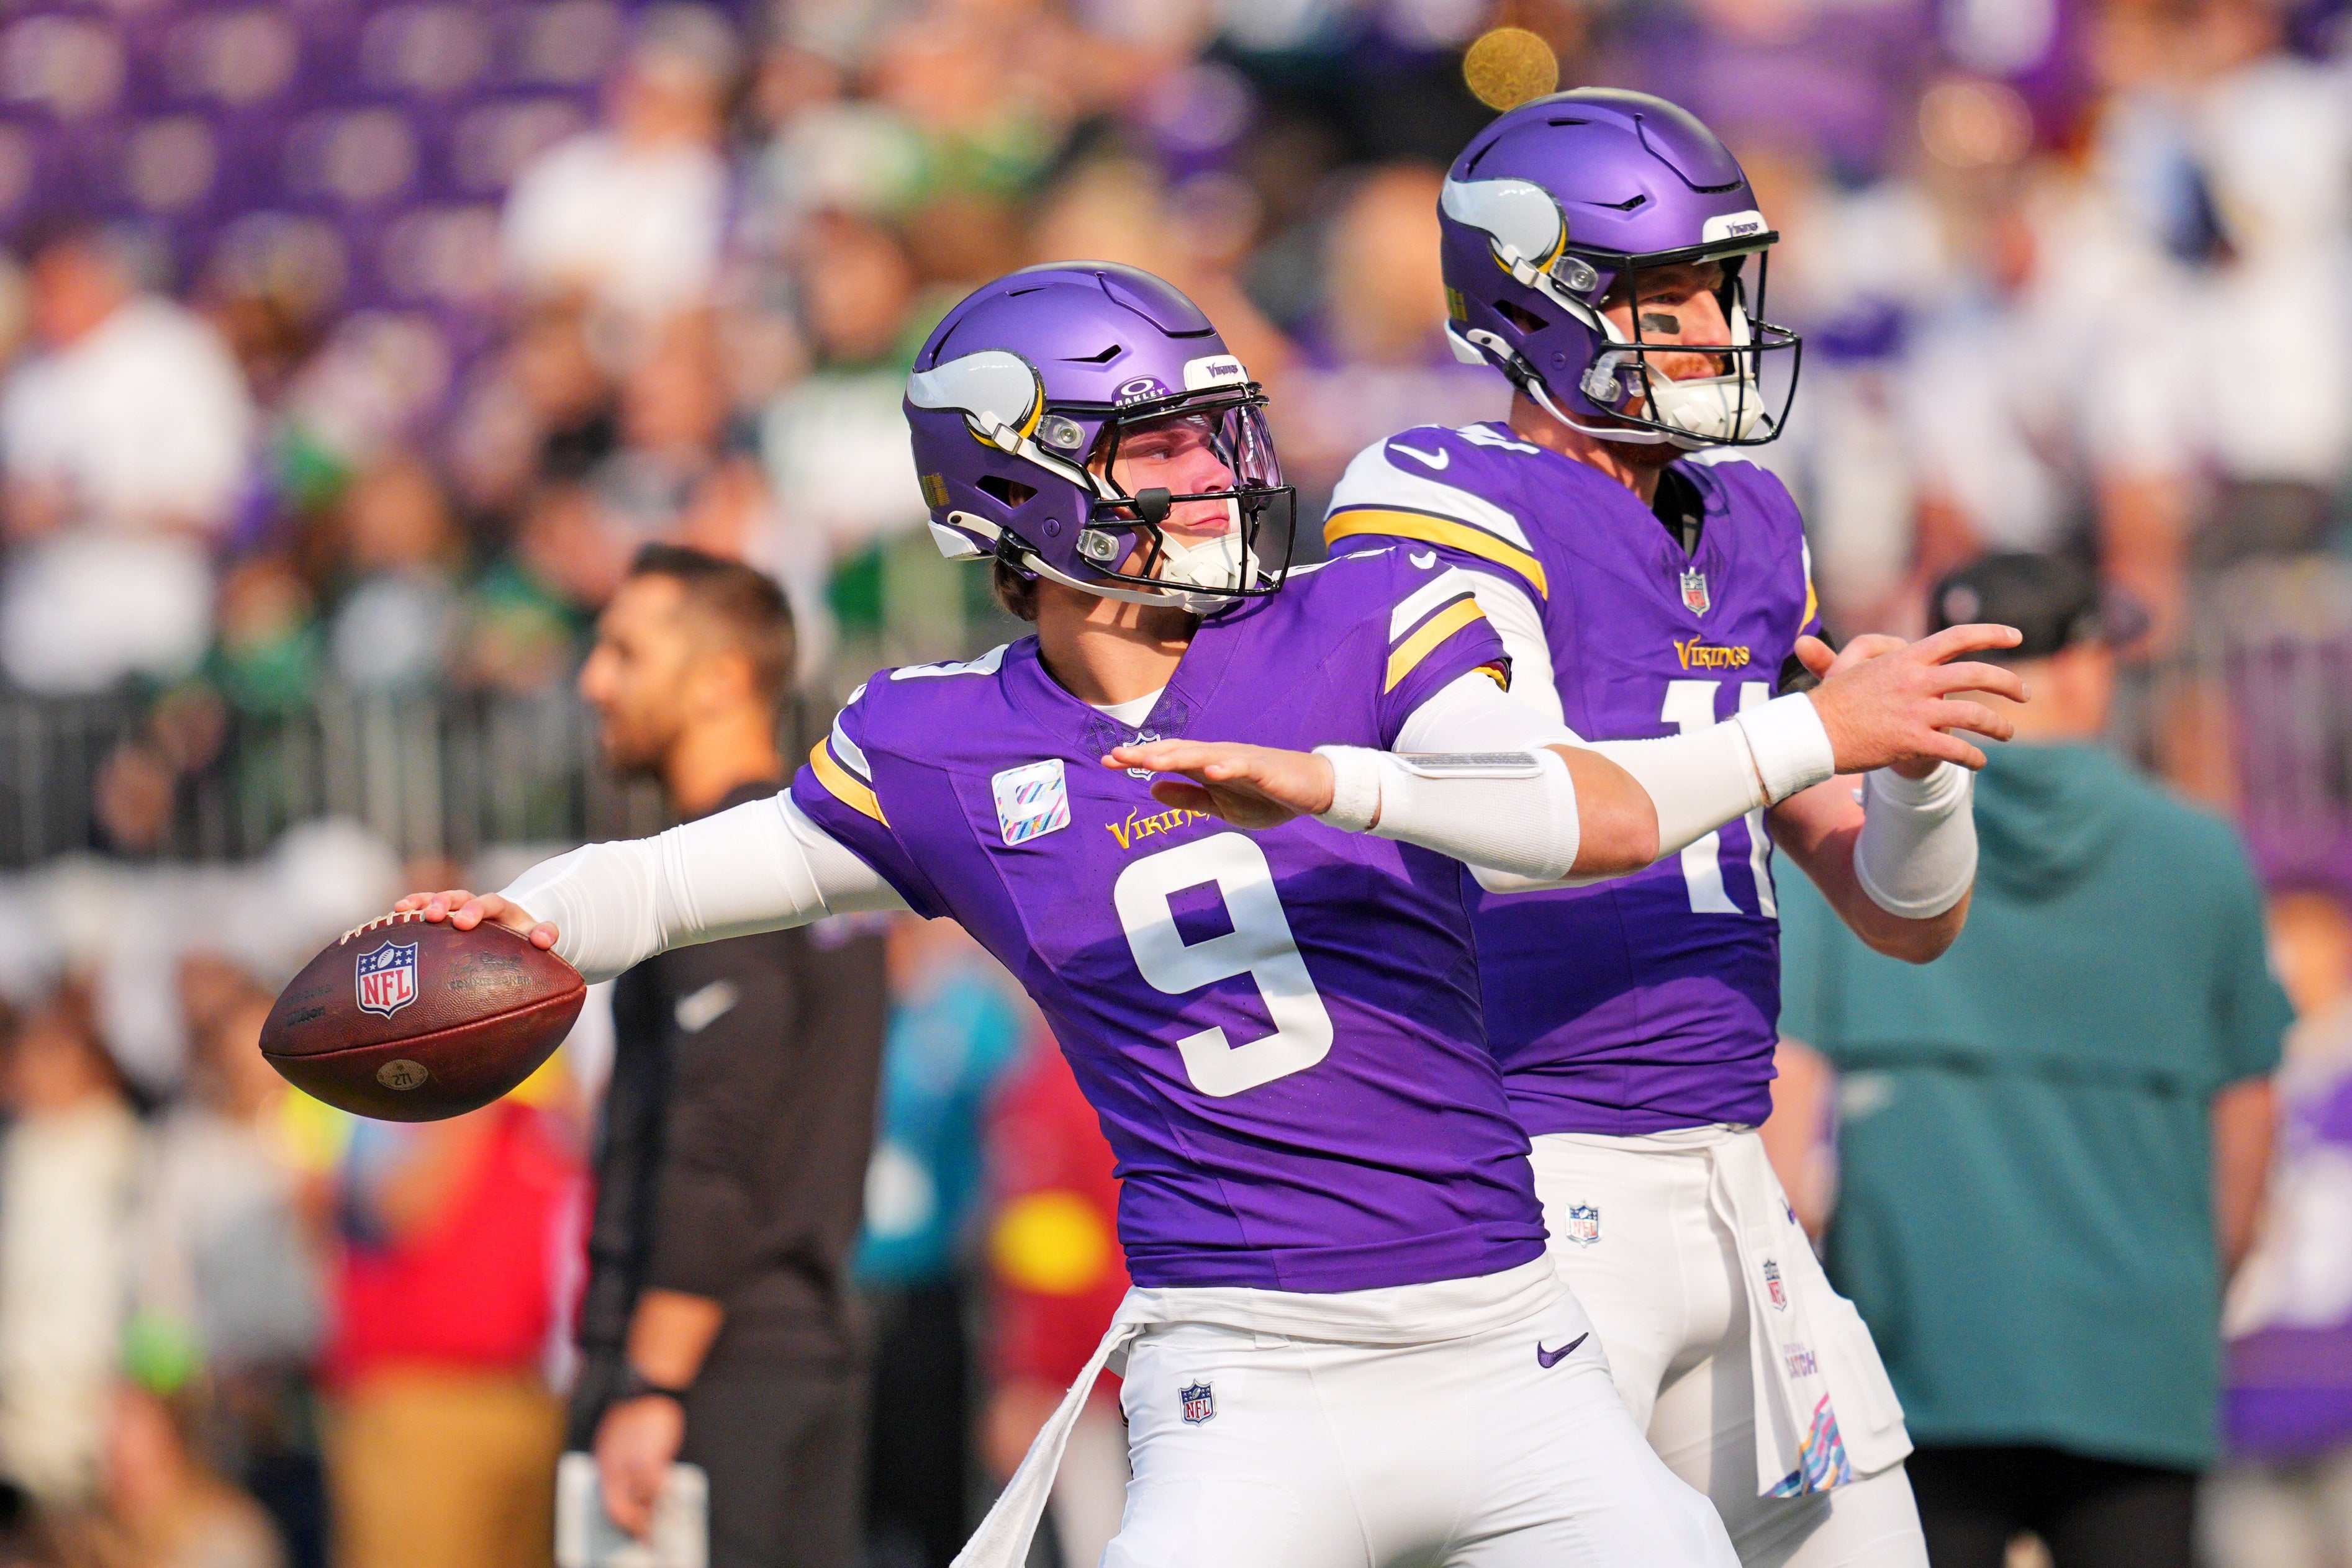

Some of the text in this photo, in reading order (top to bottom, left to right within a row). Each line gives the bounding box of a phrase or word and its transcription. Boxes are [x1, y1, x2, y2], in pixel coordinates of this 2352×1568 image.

[1116, 387, 1164, 407] OAKLEY
[1673, 634, 1750, 670] VIKINGS
[1105, 806, 1211, 849] VIKIN
[1113, 832, 1334, 1097] 9
[363, 969, 410, 1006] NFL
[1573, 1220, 1598, 1238] NFL
[1185, 1399, 1211, 1418] NFL
